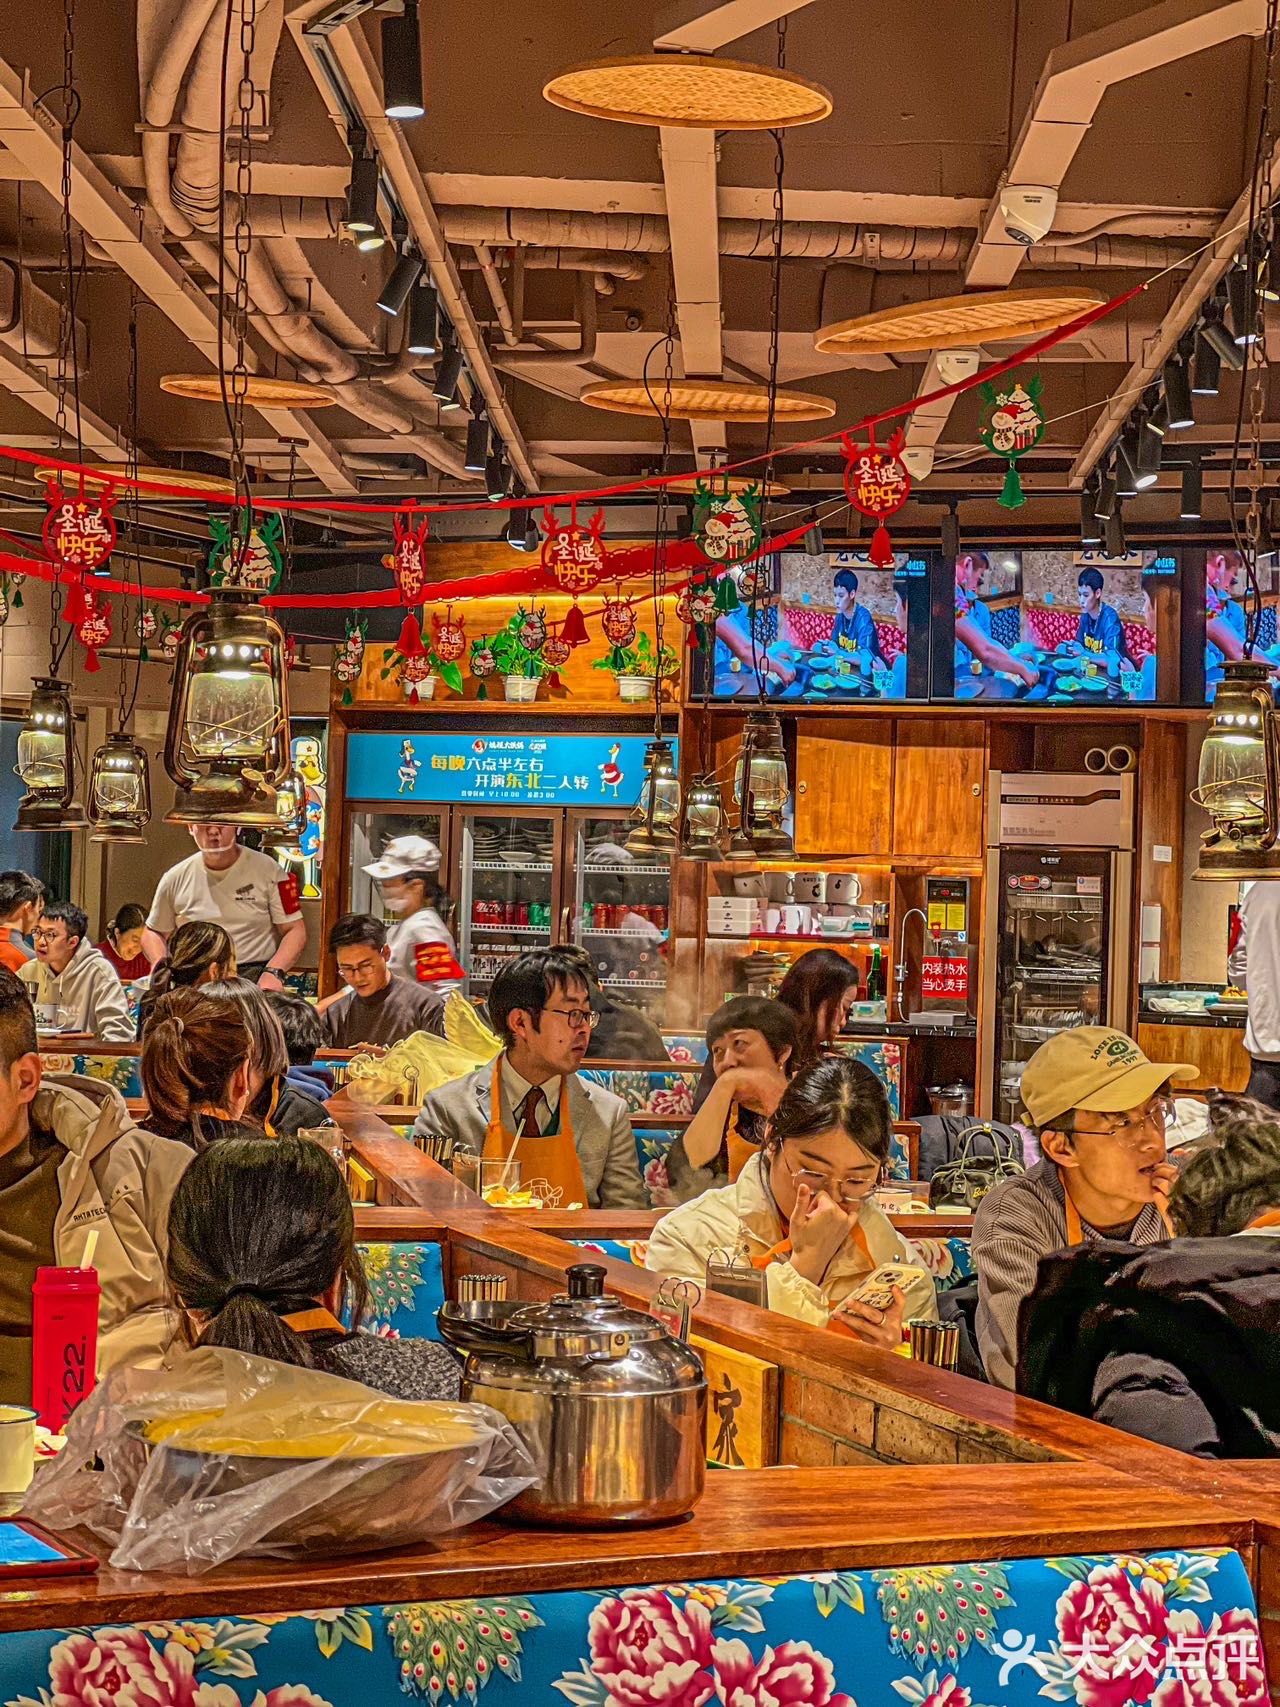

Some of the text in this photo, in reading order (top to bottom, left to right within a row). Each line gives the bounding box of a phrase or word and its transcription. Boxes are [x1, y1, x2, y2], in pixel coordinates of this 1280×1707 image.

[855, 456, 903, 485] 圣诞
[857, 483, 902, 507] 快乐
[55, 504, 108, 536] 圣诞
[57, 532, 104, 560] 快乐
[400, 540, 422, 571] 圣诞
[552, 532, 600, 563] 圣诞
[400, 568, 422, 595] 快乐
[554, 560, 597, 586] 快乐
[438, 626, 463, 645] 圣诞
[437, 641, 461, 657] 快乐
[431, 755, 544, 771] 每晚六点半左右
[475, 773, 590, 790] 开演东北二人转
[922, 962, 968, 976] 内装热水
[922, 978, 968, 992] 当心烫手
[1090, 1040, 1110, 1061] LOSE
